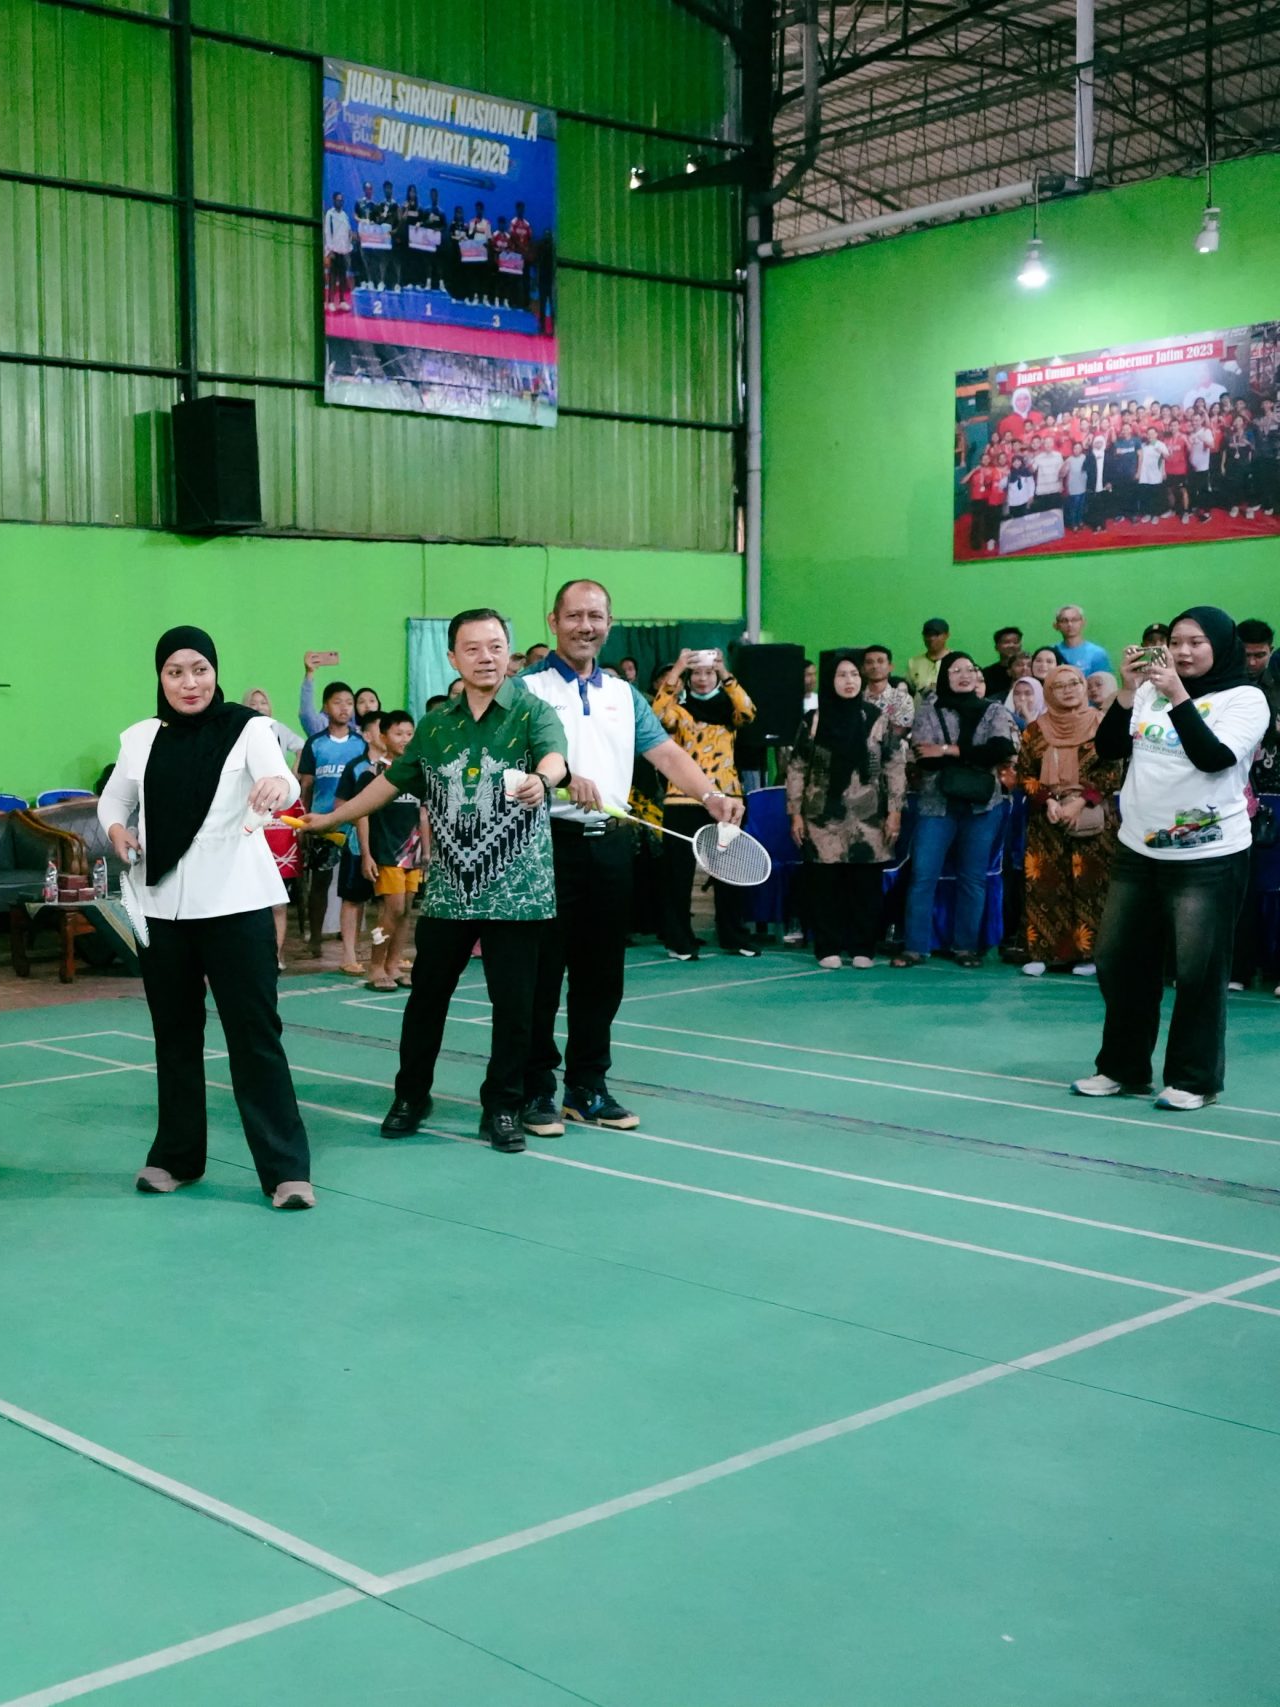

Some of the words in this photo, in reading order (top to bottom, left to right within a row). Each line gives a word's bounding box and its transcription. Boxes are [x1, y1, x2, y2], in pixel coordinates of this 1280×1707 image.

[342, 69, 393, 110] JUARA
[395, 81, 454, 124] SIRKUIT
[454, 95, 526, 140] NASIONAL
[526, 112, 539, 142] A
[377, 117, 407, 154] DKI
[404, 125, 470, 168] JAKARTA
[471, 140, 510, 175] 2026
[373, 300, 382, 315] 2
[425, 302, 433, 316] 1
[492, 314, 501, 328] 3
[1016, 370, 1043, 387] Juara
[1077, 361, 1104, 376] Piala
[1105, 353, 1153, 371] Gubernur
[1155, 348, 1184, 365] Jatim
[1186, 342, 1214, 360] 2023
